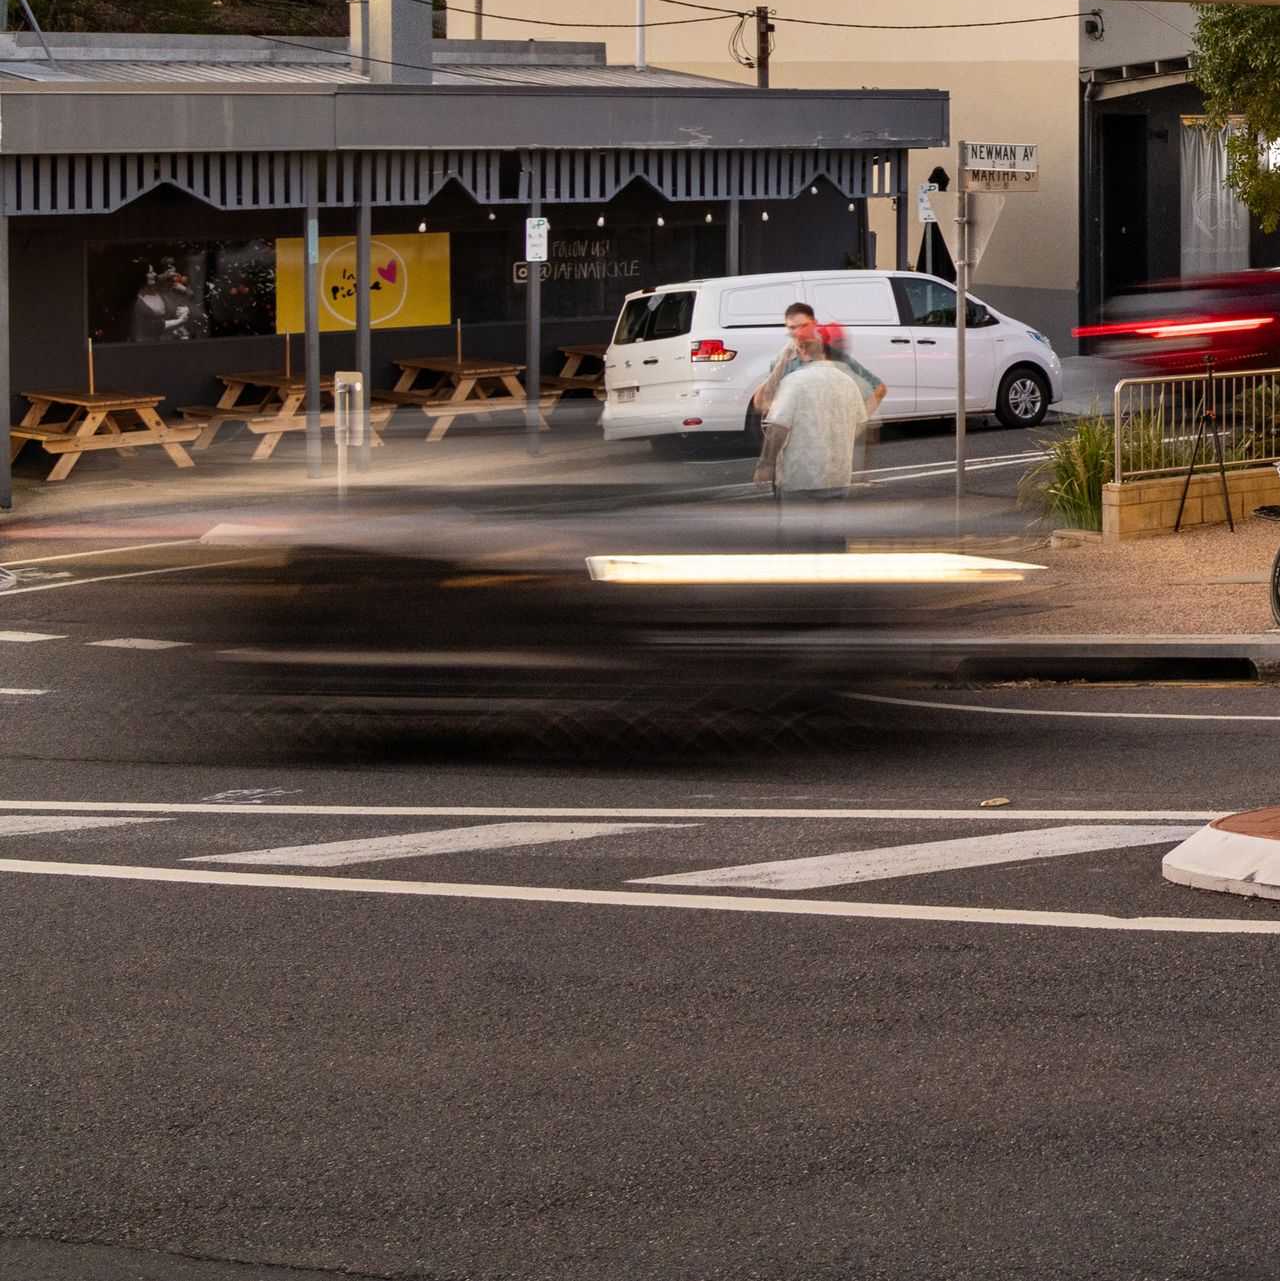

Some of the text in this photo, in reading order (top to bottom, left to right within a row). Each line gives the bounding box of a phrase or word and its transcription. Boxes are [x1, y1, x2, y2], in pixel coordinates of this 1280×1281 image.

[971, 145, 1034, 161] NEWMAN AV
[972, 170, 1017, 182] MARTHA
